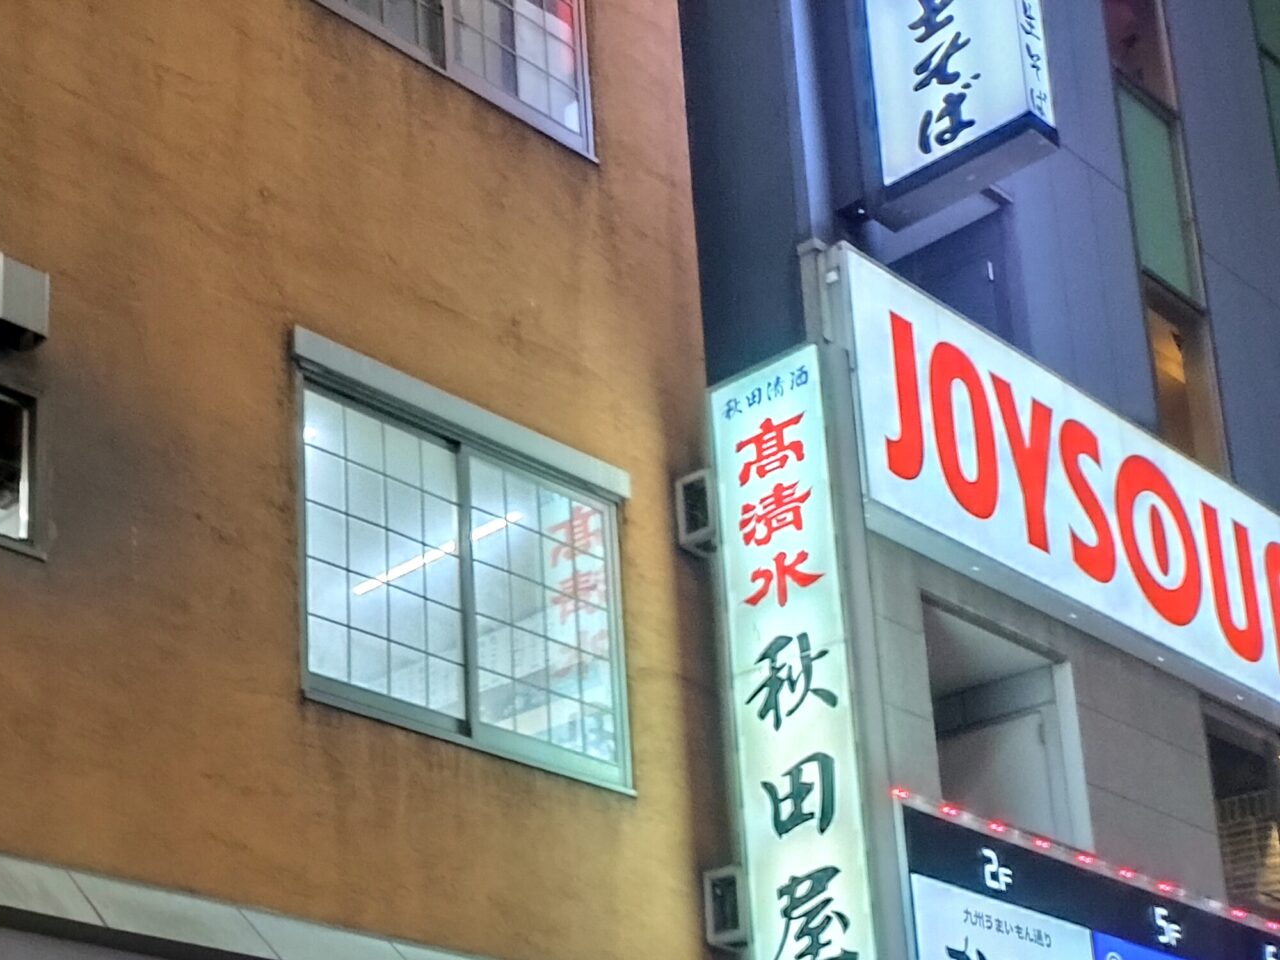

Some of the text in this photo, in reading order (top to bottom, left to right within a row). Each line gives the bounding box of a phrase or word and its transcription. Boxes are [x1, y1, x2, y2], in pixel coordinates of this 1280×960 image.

[886, 311, 1280, 672] JOYSOU
[981, 847, 1012, 891] 2F
[963, 908, 1052, 948] 九州うまいもん通り
[1153, 906, 1181, 947] 5F
